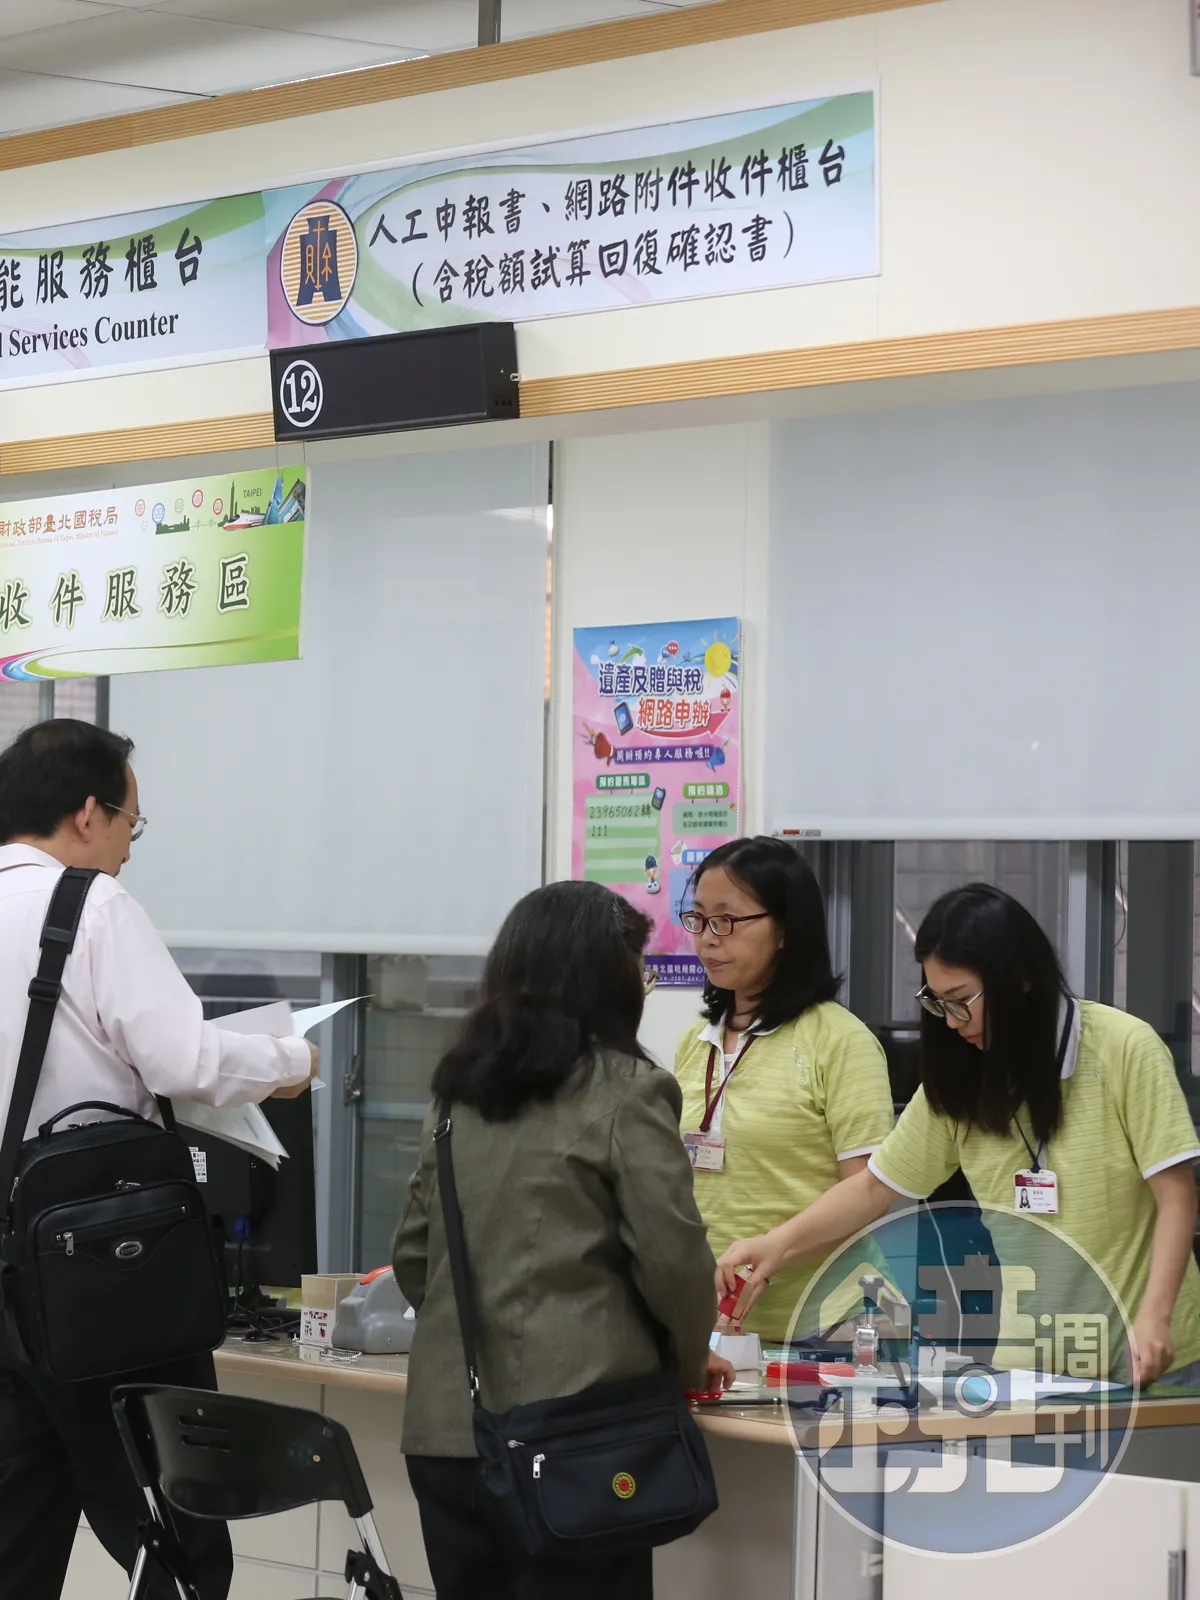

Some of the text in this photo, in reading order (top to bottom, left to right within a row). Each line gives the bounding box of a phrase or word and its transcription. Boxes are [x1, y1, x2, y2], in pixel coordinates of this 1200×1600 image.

[368, 137, 848, 249] 人工申報書、網路附件收件櫃台
[8, 324, 88, 357] Services
[94, 311, 179, 344] Counter
[283, 366, 321, 422] 12
[243, 488, 262, 499] TAIPEI
[599, 662, 702, 694] 遺產及贈與稅
[637, 697, 710, 727] 網路申辦
